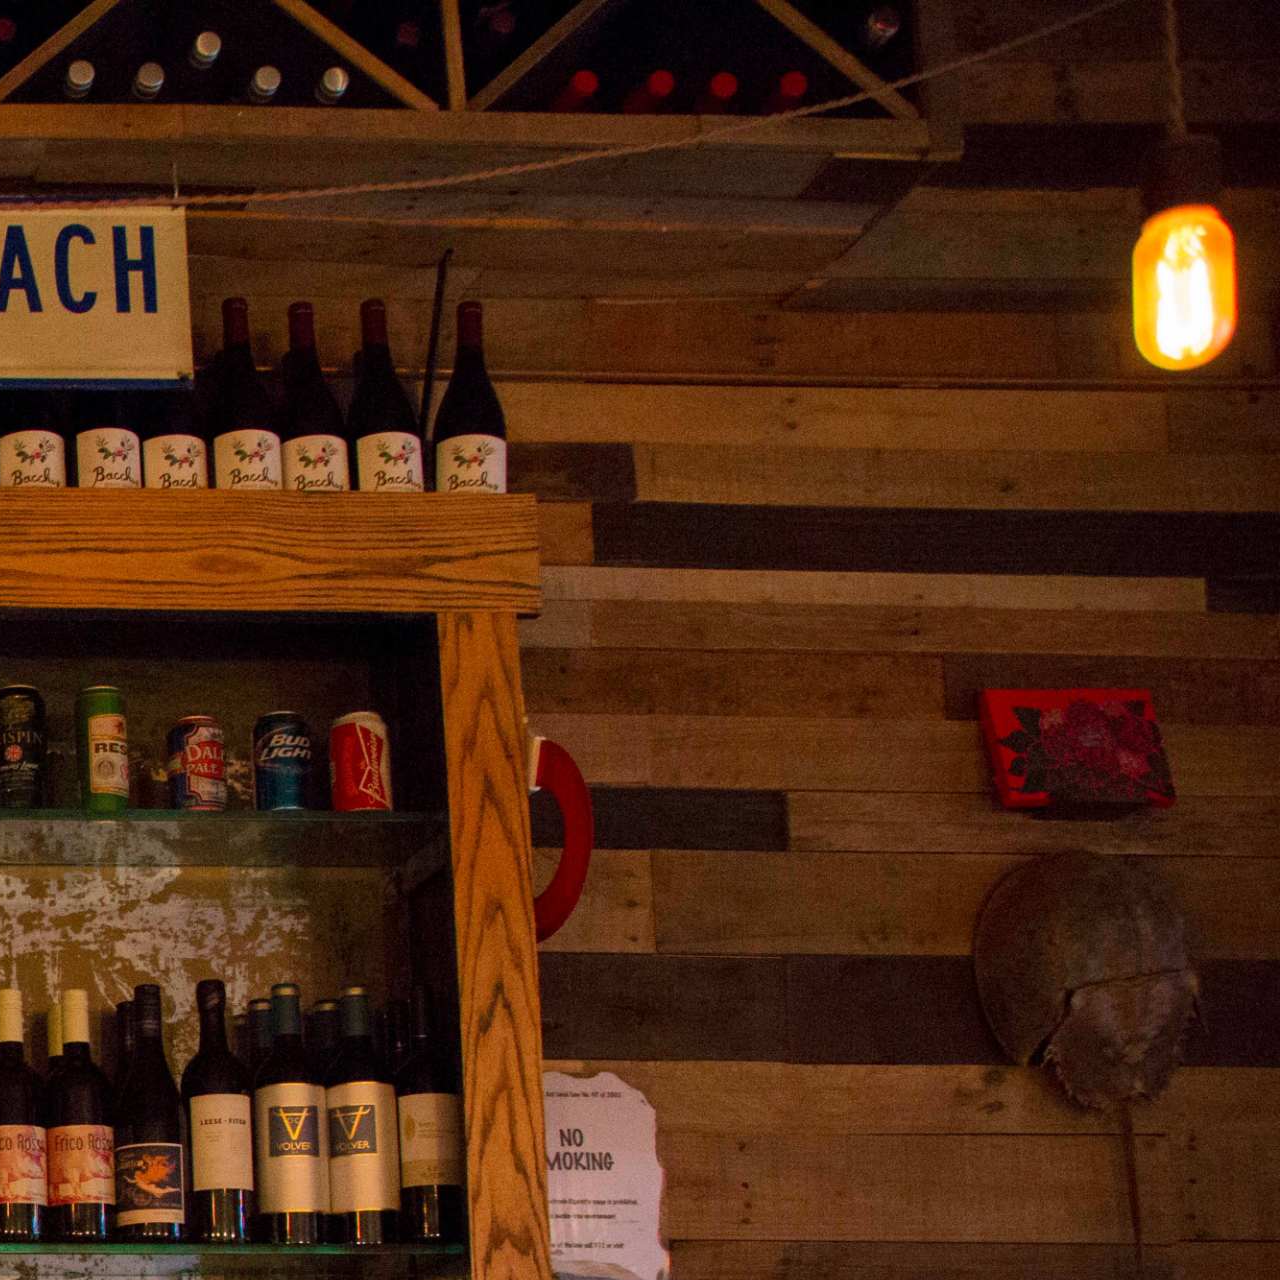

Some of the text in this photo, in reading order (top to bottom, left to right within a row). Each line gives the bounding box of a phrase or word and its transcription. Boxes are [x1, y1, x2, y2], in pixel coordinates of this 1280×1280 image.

[270, 732, 311, 748] BUD
[54, 1135, 84, 1152] Frico
[559, 1128, 584, 1147] NO
[546, 1151, 615, 1171] MOKING
